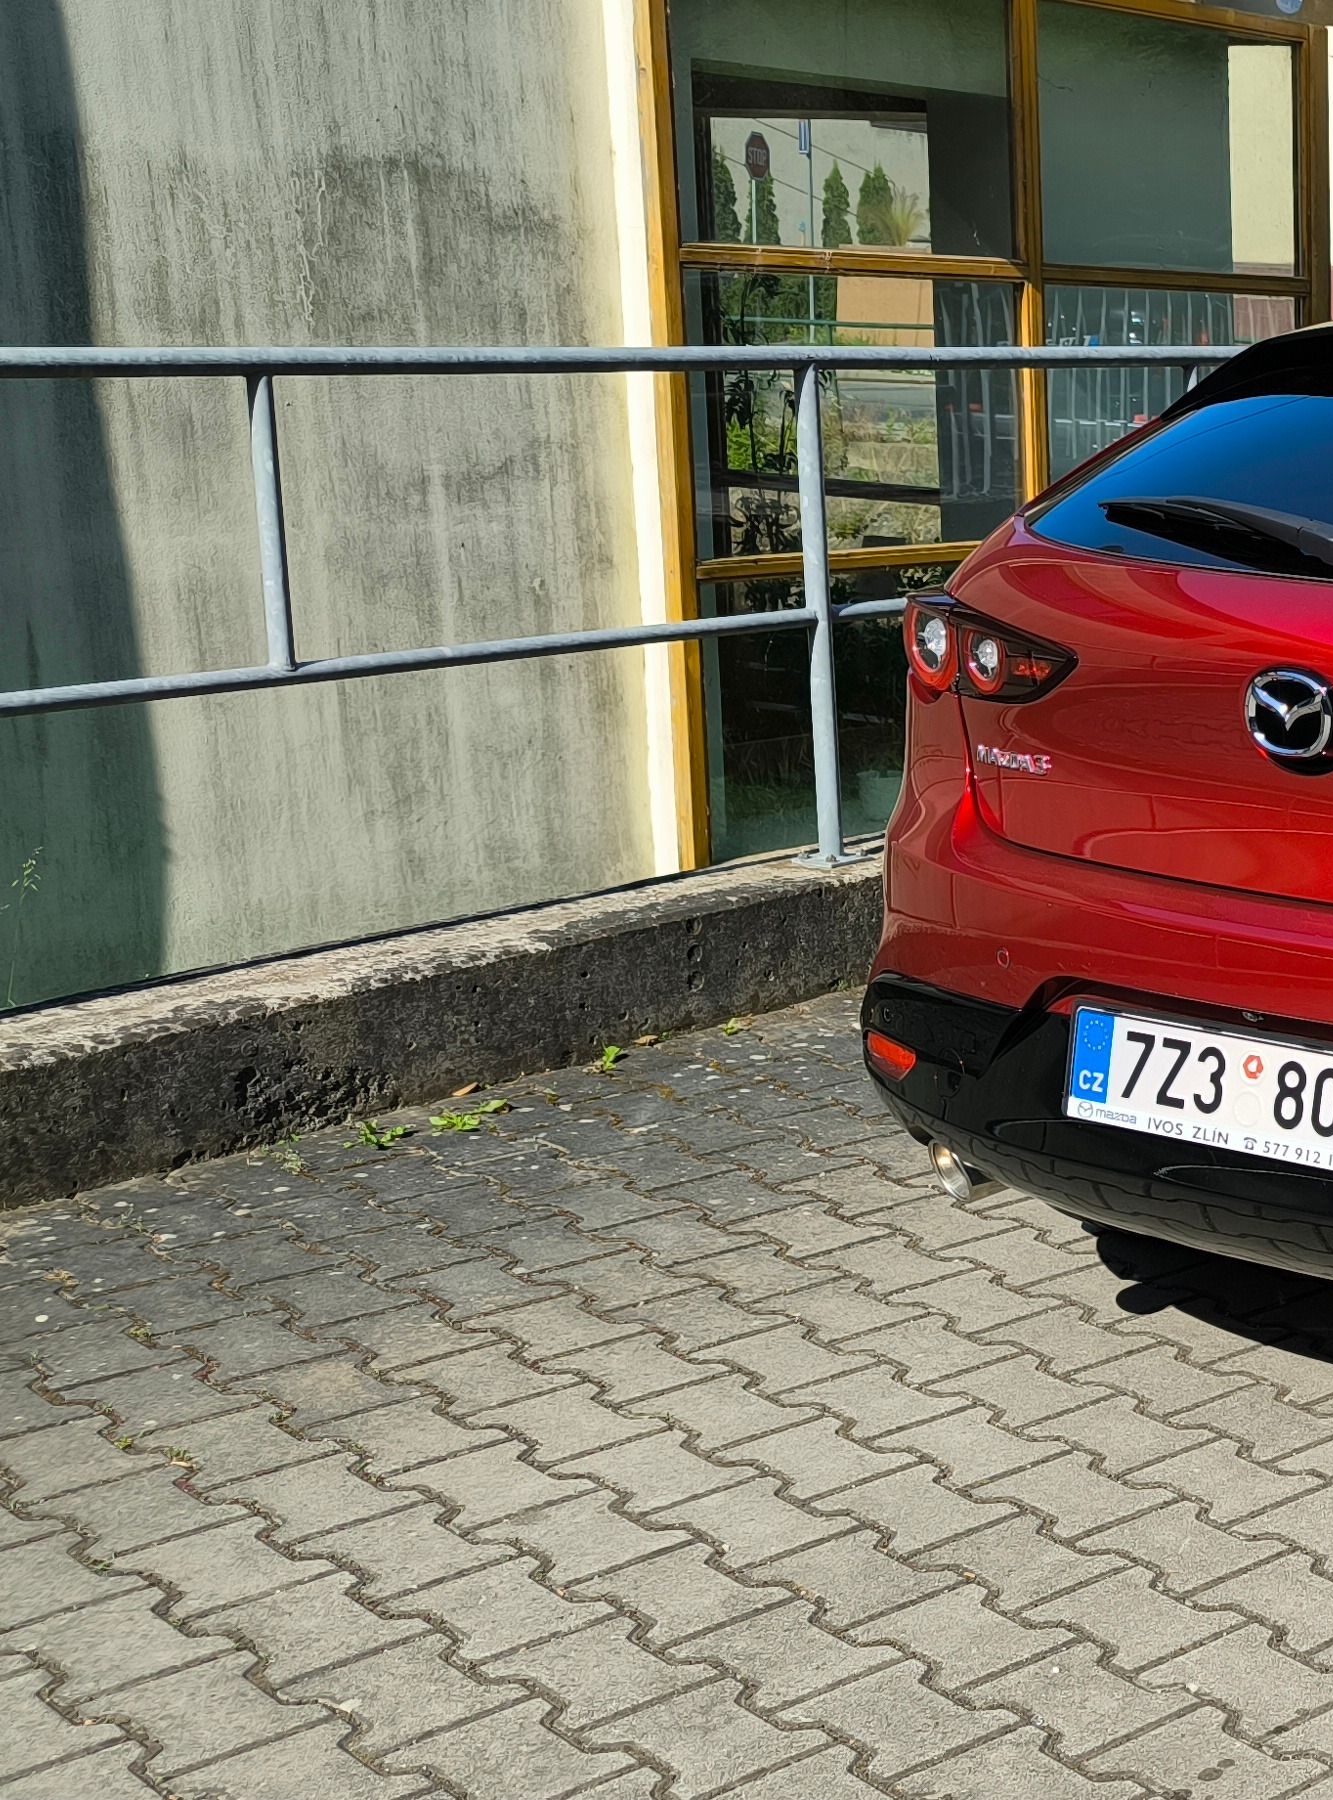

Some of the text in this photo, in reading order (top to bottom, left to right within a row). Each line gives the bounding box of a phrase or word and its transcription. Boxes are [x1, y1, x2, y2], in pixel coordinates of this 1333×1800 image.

[747, 146, 768, 167] STOP
[1079, 1069, 1104, 1093] CZ
[1121, 1030, 1226, 1114] 7Z3
[1147, 1117, 1184, 1136] IVOS
[1192, 1126, 1230, 1145] ZLÍN
[1262, 1140, 1290, 1157] 577
[1295, 1147, 1321, 1164] 912
